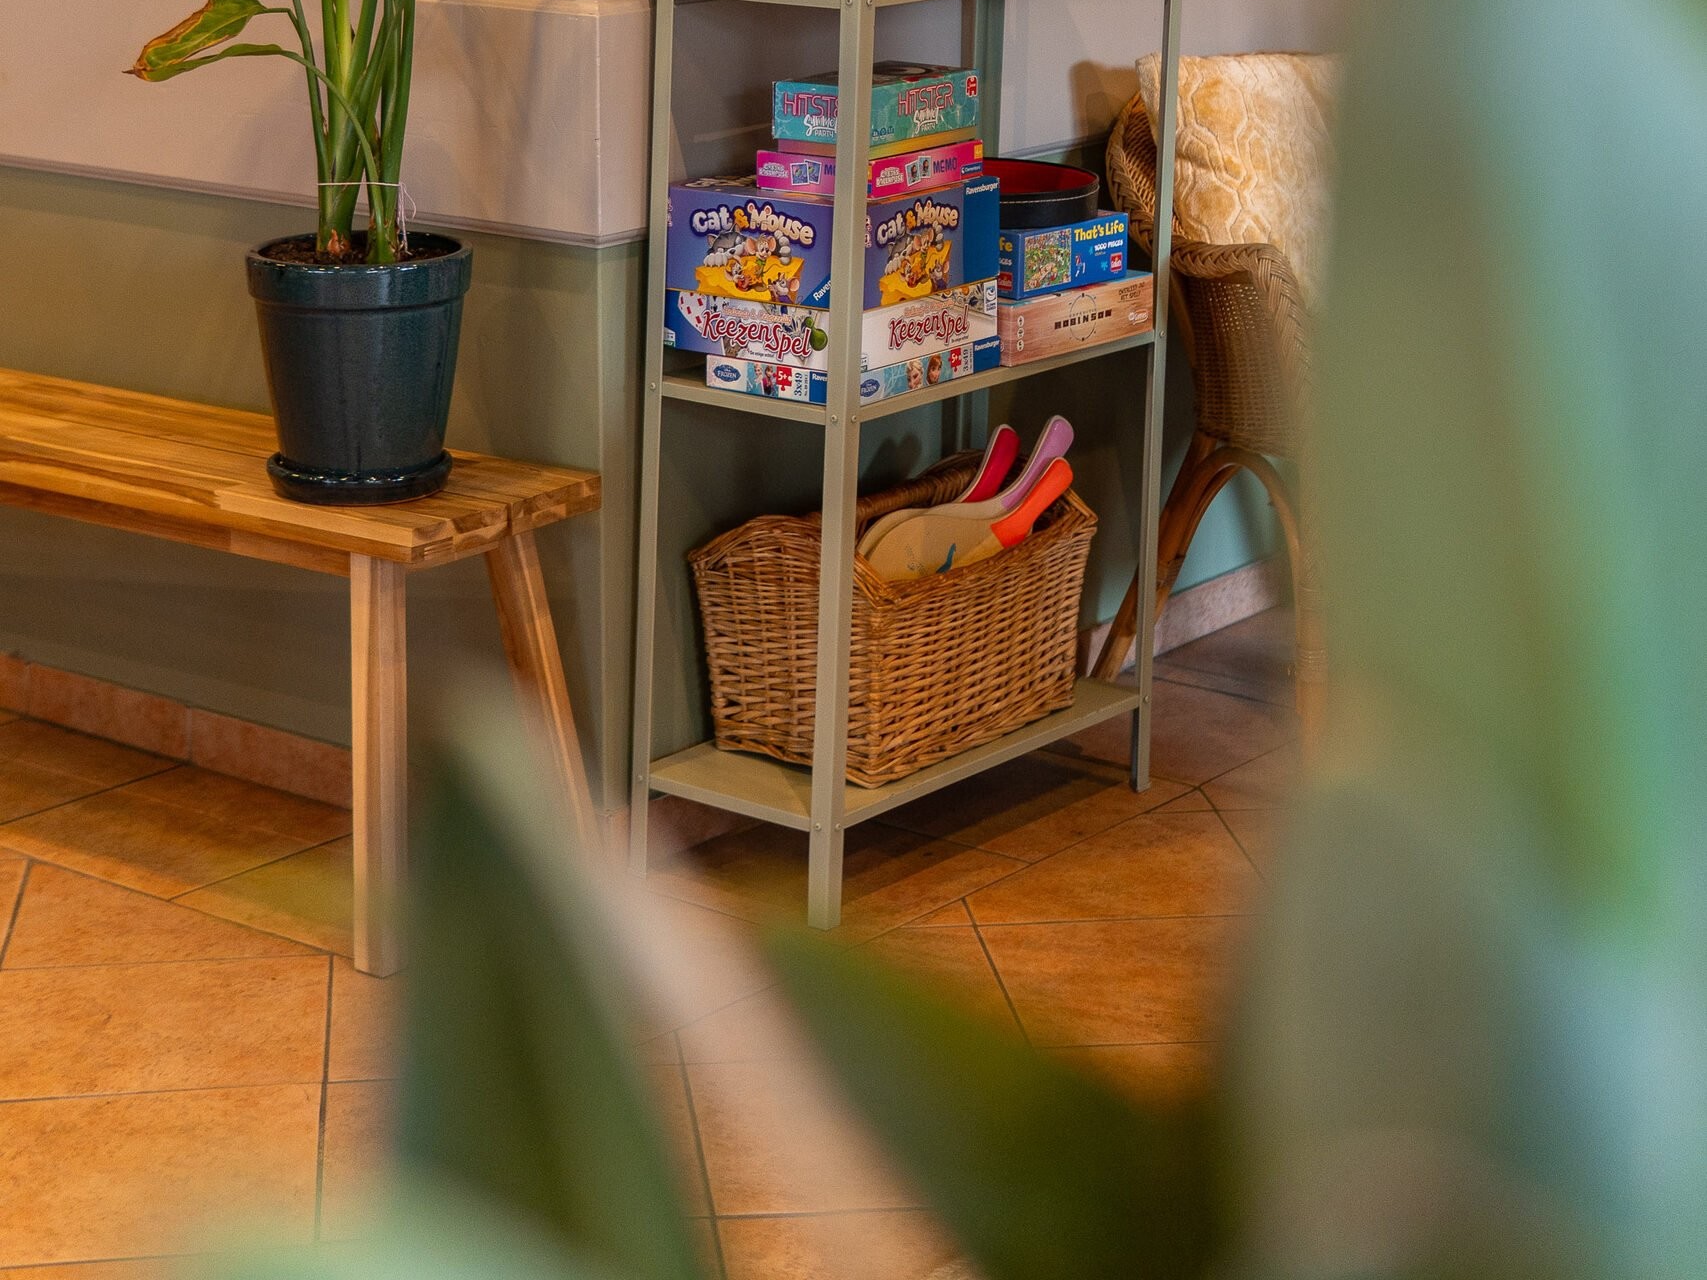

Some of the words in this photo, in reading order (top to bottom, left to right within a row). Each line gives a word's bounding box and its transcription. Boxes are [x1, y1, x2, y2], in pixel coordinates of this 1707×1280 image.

[783, 92, 839, 118] HITST
[897, 82, 954, 117] HITSTER
[814, 128, 834, 138] PARTY
[932, 157, 958, 175] MEMO
[965, 181, 999, 195] Ravensburger
[692, 206, 733, 233] Cat
[733, 208, 750, 230] &
[747, 201, 814, 246] Mouse
[877, 211, 905, 245] Cat
[905, 210, 917, 231] &
[914, 199, 959, 227] Mouse
[1074, 223, 1105, 242] That's
[1105, 220, 1125, 236] Life
[1000, 236, 1013, 252] fe
[1094, 242, 1107, 252] 1000
[1054, 309, 1113, 330] ROBINSON
[951, 353, 959, 363] 5+
[717, 371, 737, 379] FROZEN
[777, 370, 788, 381] 5+
[794, 372, 803, 397] 3x49
